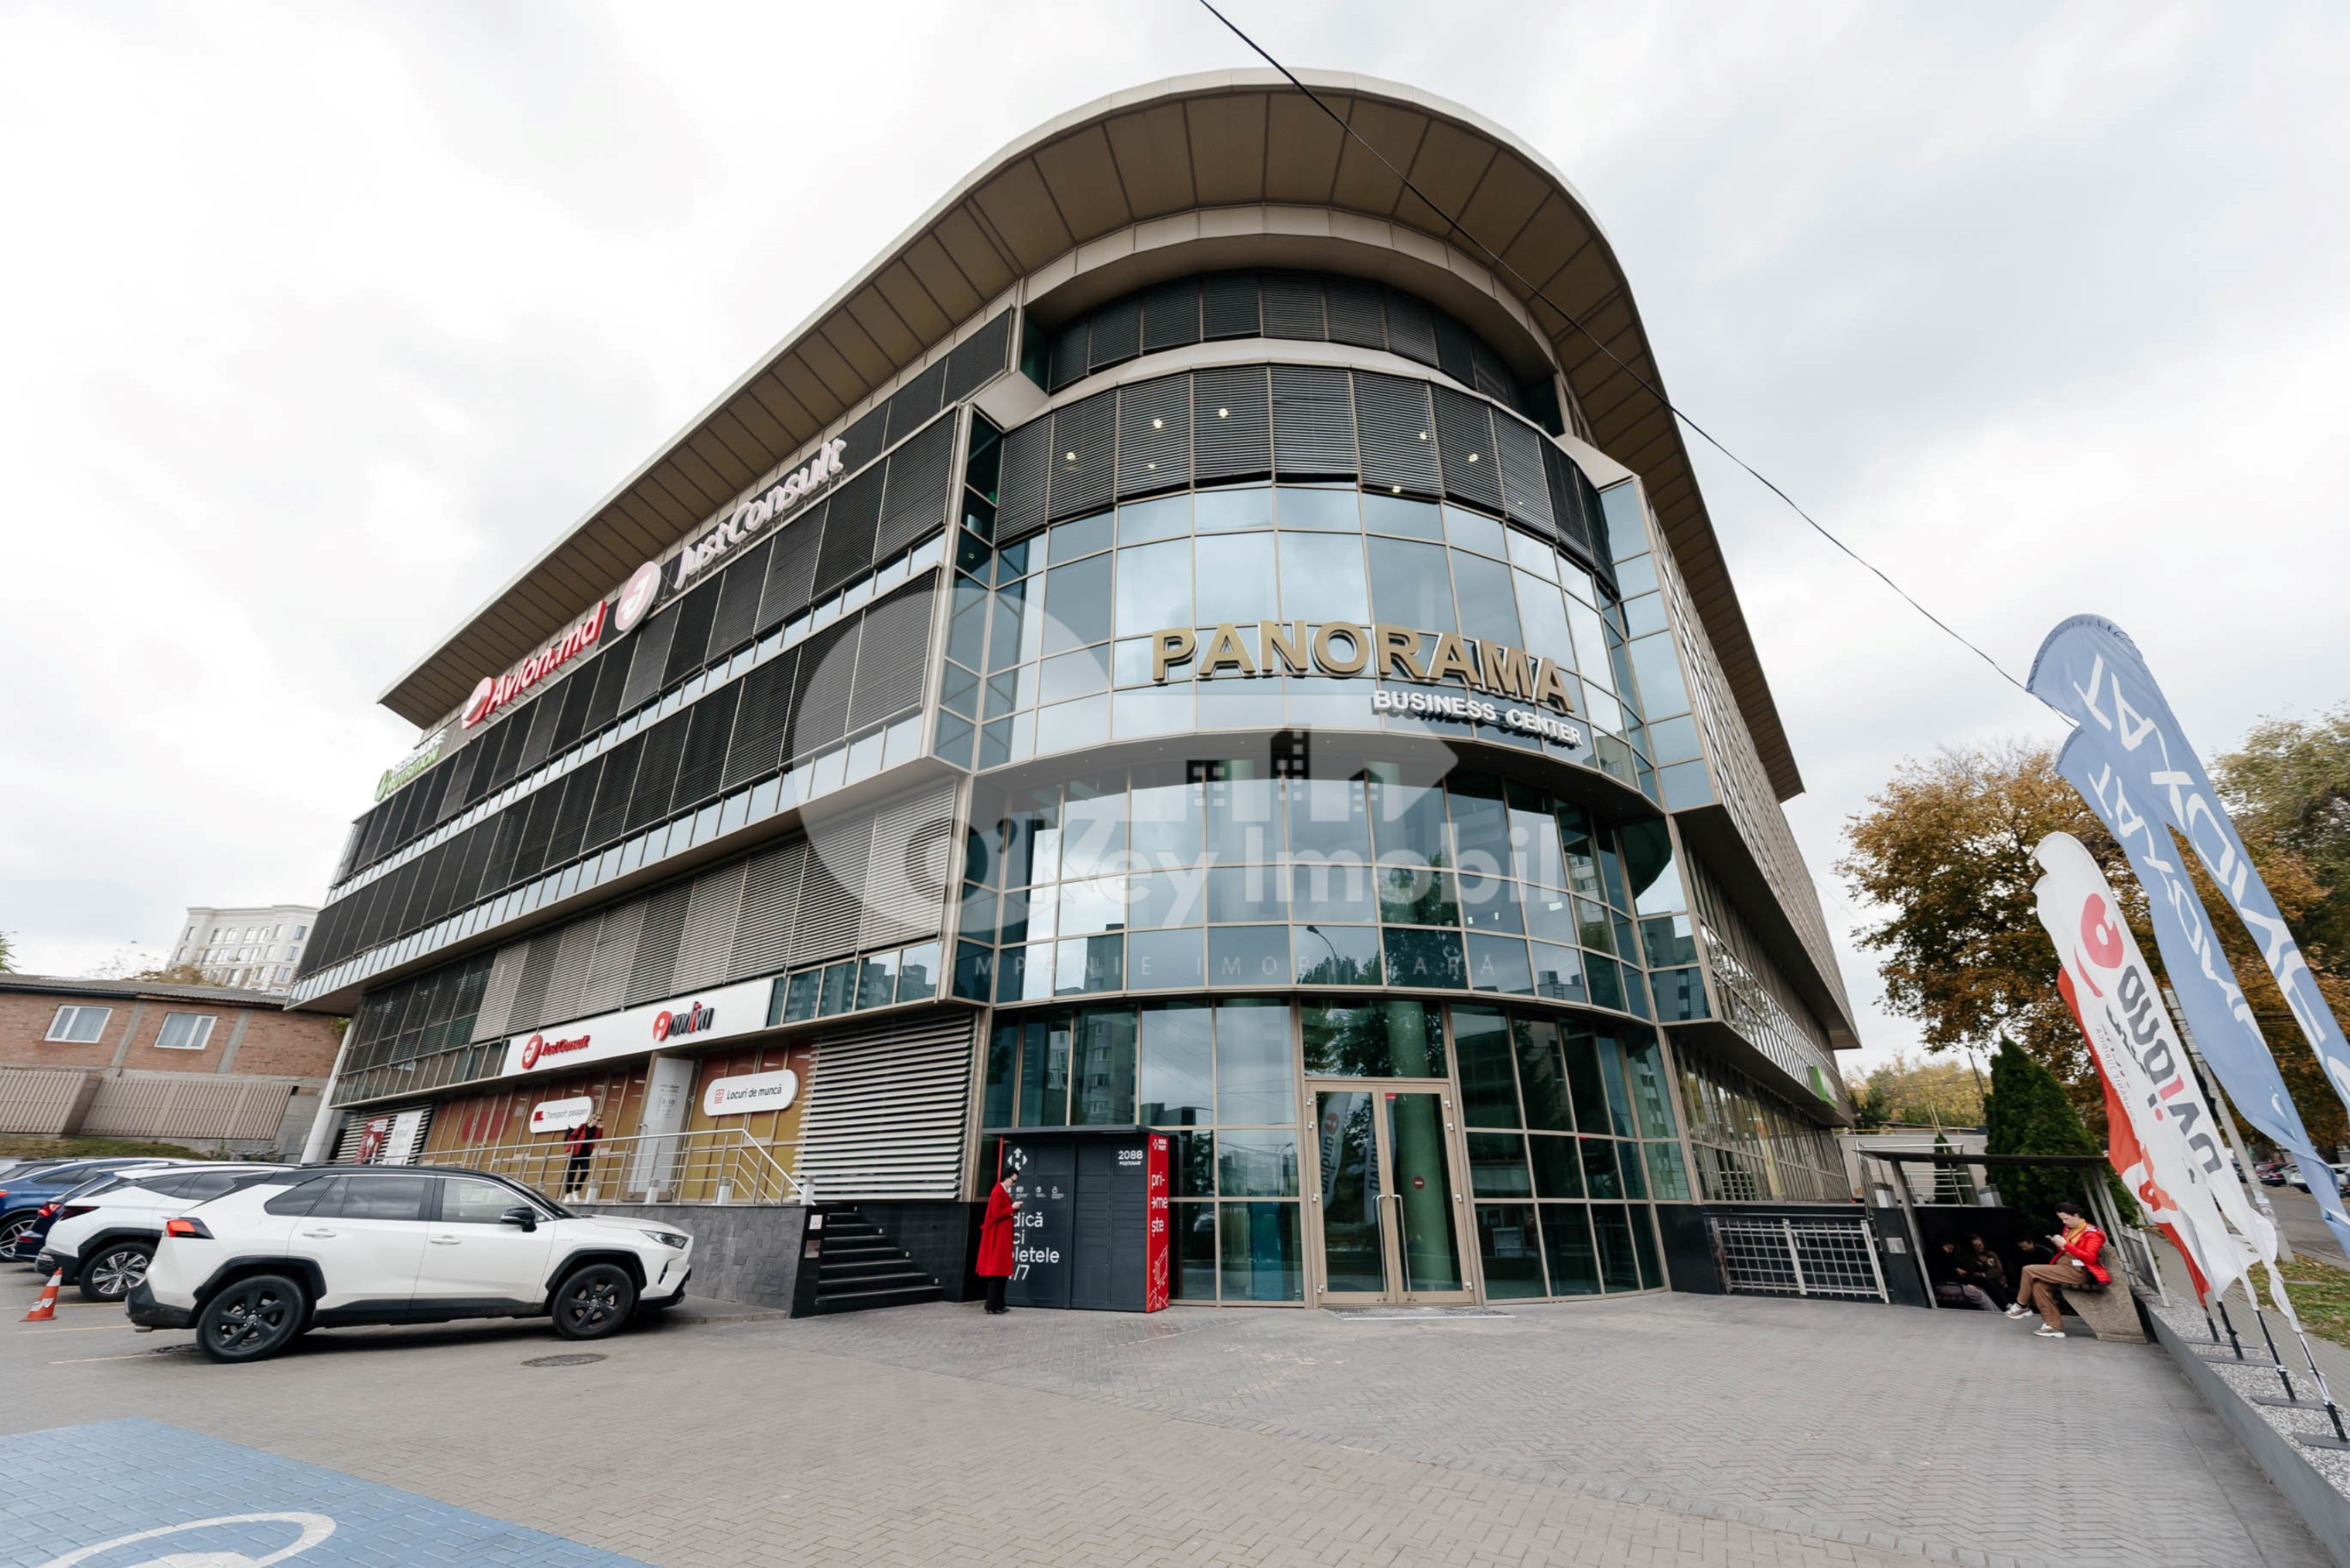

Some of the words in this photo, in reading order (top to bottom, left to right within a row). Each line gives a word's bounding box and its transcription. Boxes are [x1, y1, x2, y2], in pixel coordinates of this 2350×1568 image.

[673, 438, 847, 590] JustConsult
[485, 600, 607, 714] Avion.md
[1153, 620, 1575, 713] PANORAMA
[1373, 690, 1497, 721] BUSINESS
[1506, 708, 1583, 747] CENTER
[727, 1088, 748, 1100] Locuri
[748, 1087, 758, 1098] de
[1117, 1150, 1143, 1160] 2088
[1151, 1170, 1166, 1190] pri-
[1013, 1211, 1044, 1228] dică
[1012, 1246, 1060, 1264] letele
